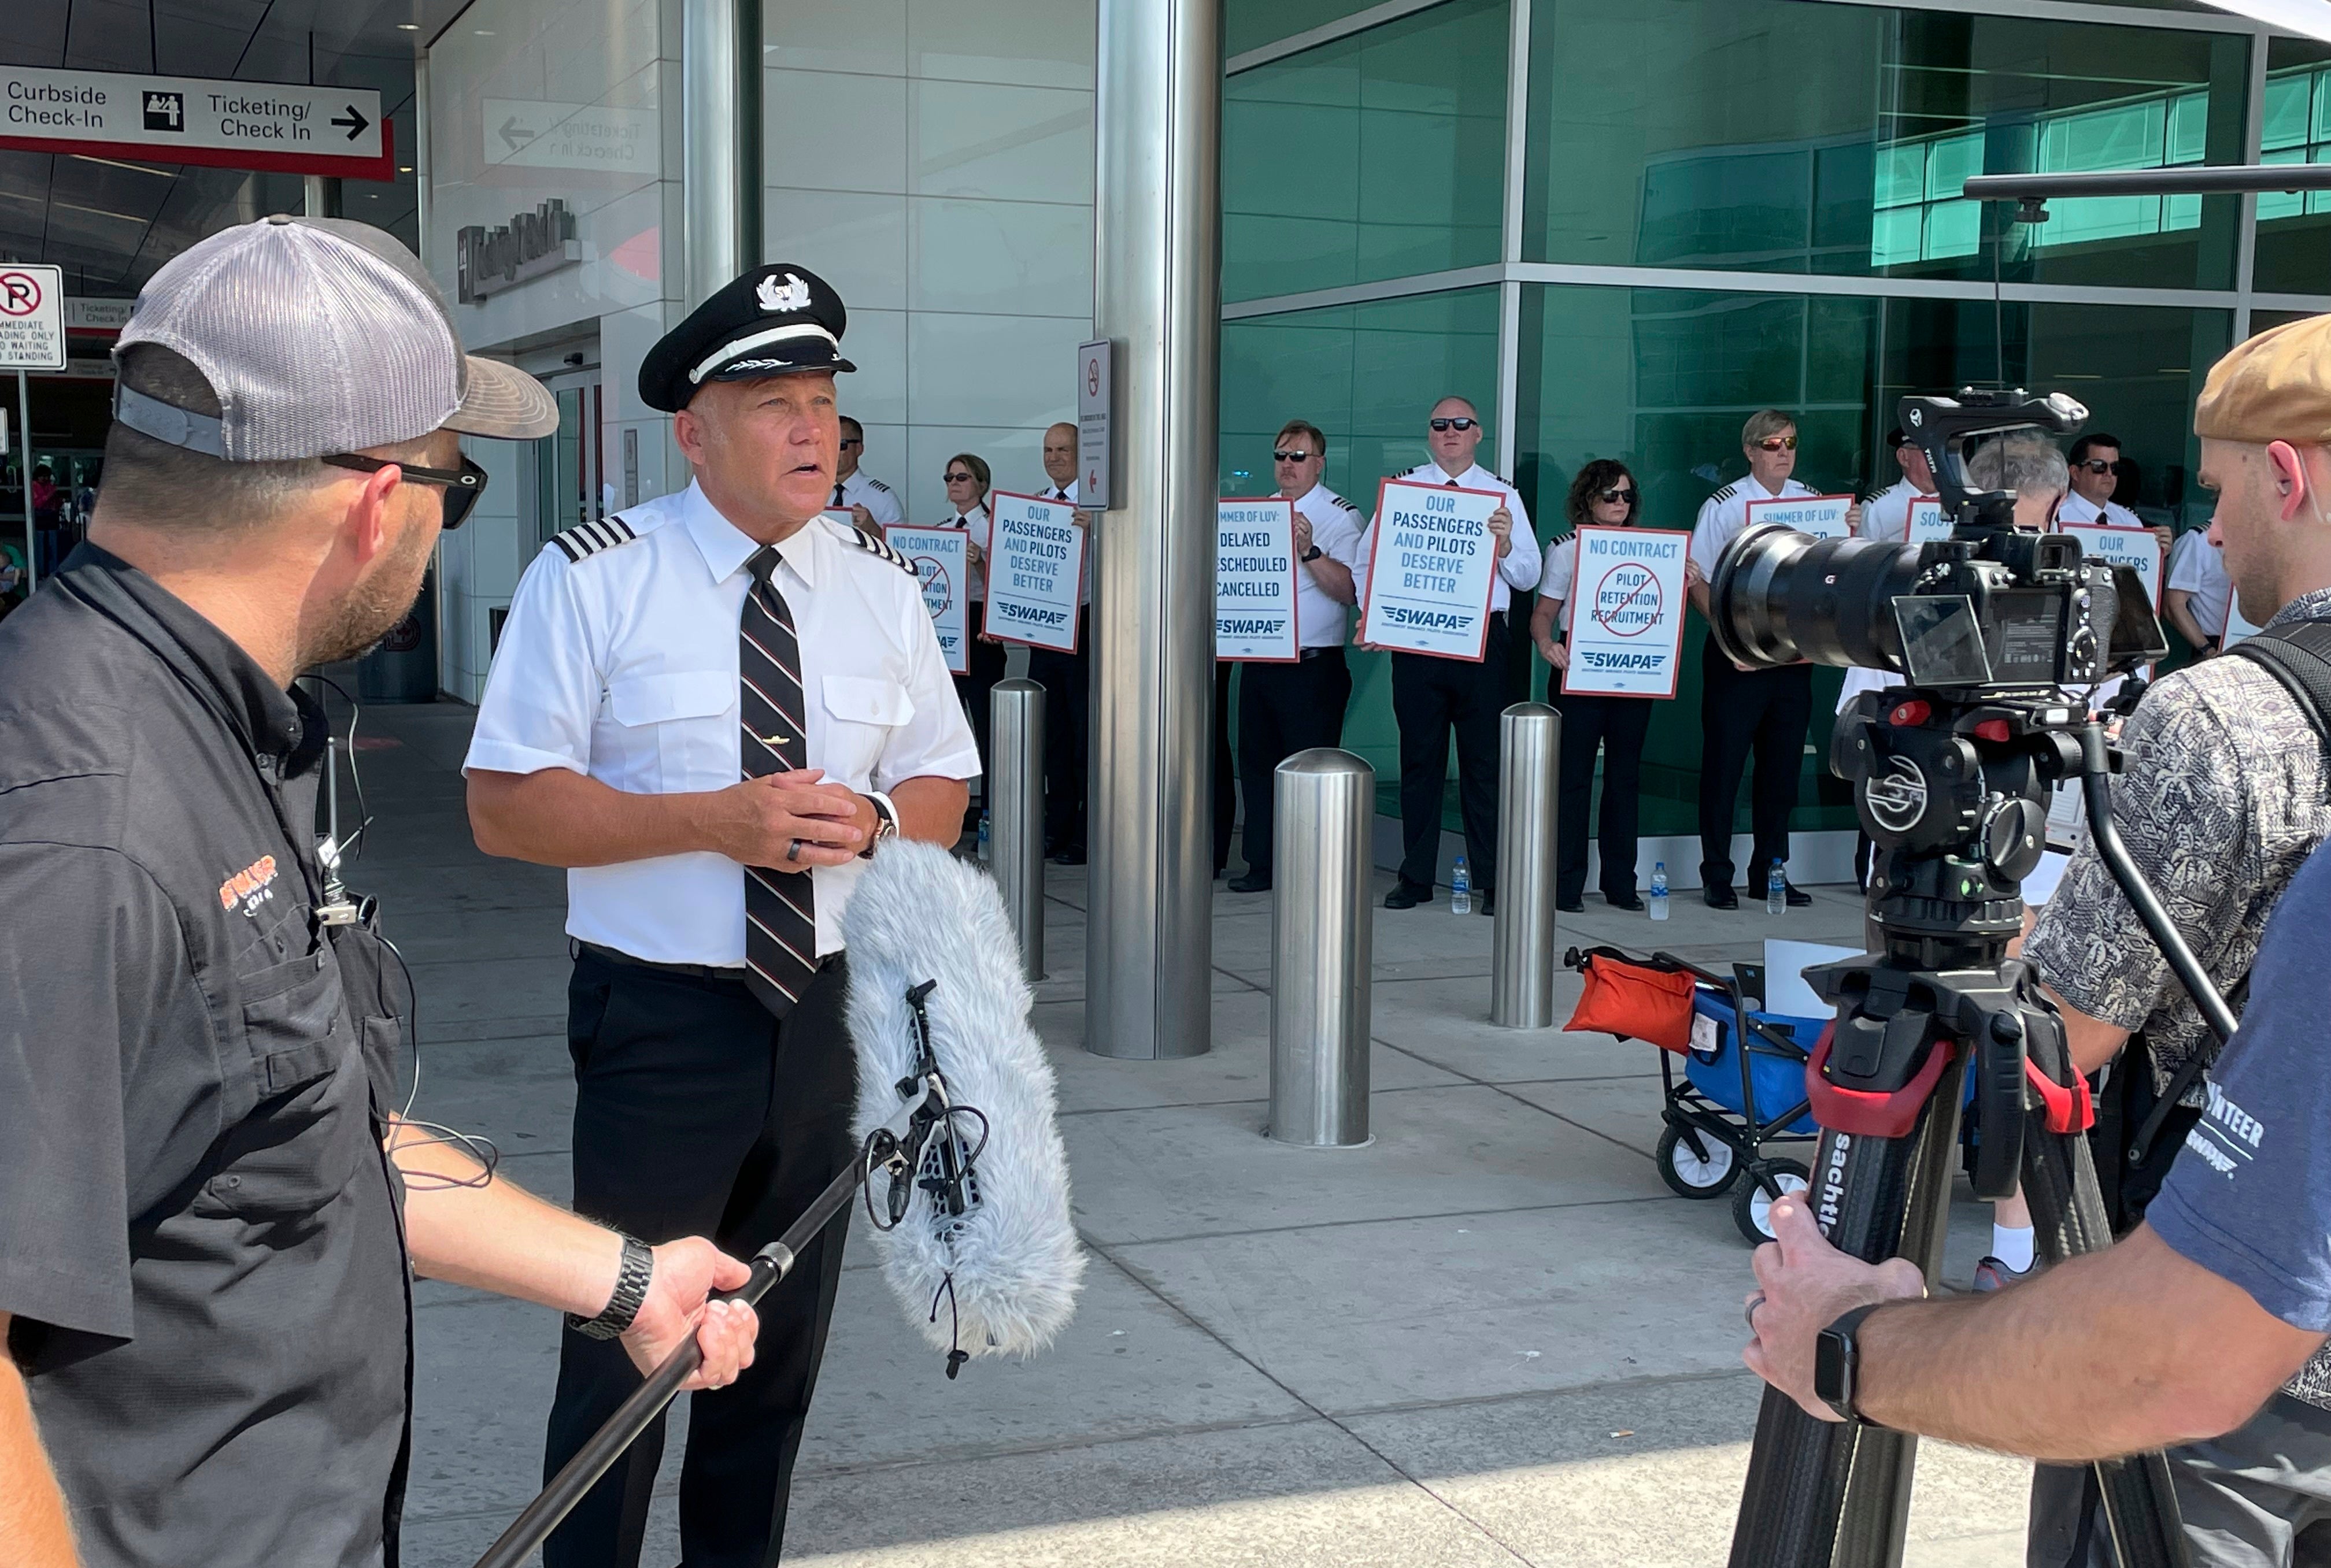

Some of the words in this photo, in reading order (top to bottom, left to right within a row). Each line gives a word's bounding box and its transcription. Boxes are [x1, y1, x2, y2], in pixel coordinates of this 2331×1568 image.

[8, 81, 106, 105] Curbside
[9, 105, 103, 128] Check-In
[207, 94, 311, 121] Ticketing/
[221, 118, 284, 139] Check
[293, 123, 310, 140] In
[8, 283, 29, 308] P
[31, 331, 54, 340] ONLY
[11, 342, 49, 350] WAITING
[8, 351, 53, 361] STANDING
[1027, 505, 1050, 522] OUR
[1426, 495, 1455, 513] OUR
[1246, 511, 1258, 522] OF
[1260, 510, 1280, 522] LUV:
[1392, 511, 1483, 536] PASSENGERS
[1763, 511, 1803, 523] SUMMER
[1805, 510, 1816, 521] OF
[1002, 519, 1072, 543] PASSENGERS
[1220, 532, 1271, 547] DELAYED
[893, 535, 906, 549] NO
[908, 536, 960, 553] CONTRACT
[1004, 537, 1027, 553] AND
[1030, 541, 1067, 560] PILOTS
[1393, 532, 1424, 549] AND
[1427, 535, 1476, 556] PILOTS
[1590, 539, 1608, 554] NO
[1611, 540, 1678, 559] CONTRACT
[2099, 536, 2124, 551] OUR
[1011, 555, 1059, 576] DESERVE
[1401, 552, 1464, 574] DESERVE
[1013, 573, 1053, 592] BETTER
[1403, 572, 1456, 594] BETTER
[1616, 573, 1646, 587] PILOT
[1600, 591, 1659, 606] RETENTION
[1008, 603, 1055, 624] SWAPA
[1395, 608, 1457, 629] SWAPA
[1590, 609, 1664, 625] RECRUITMENT
[1223, 620, 1273, 633] SWAPA
[1593, 653, 1651, 669] SWAPA
